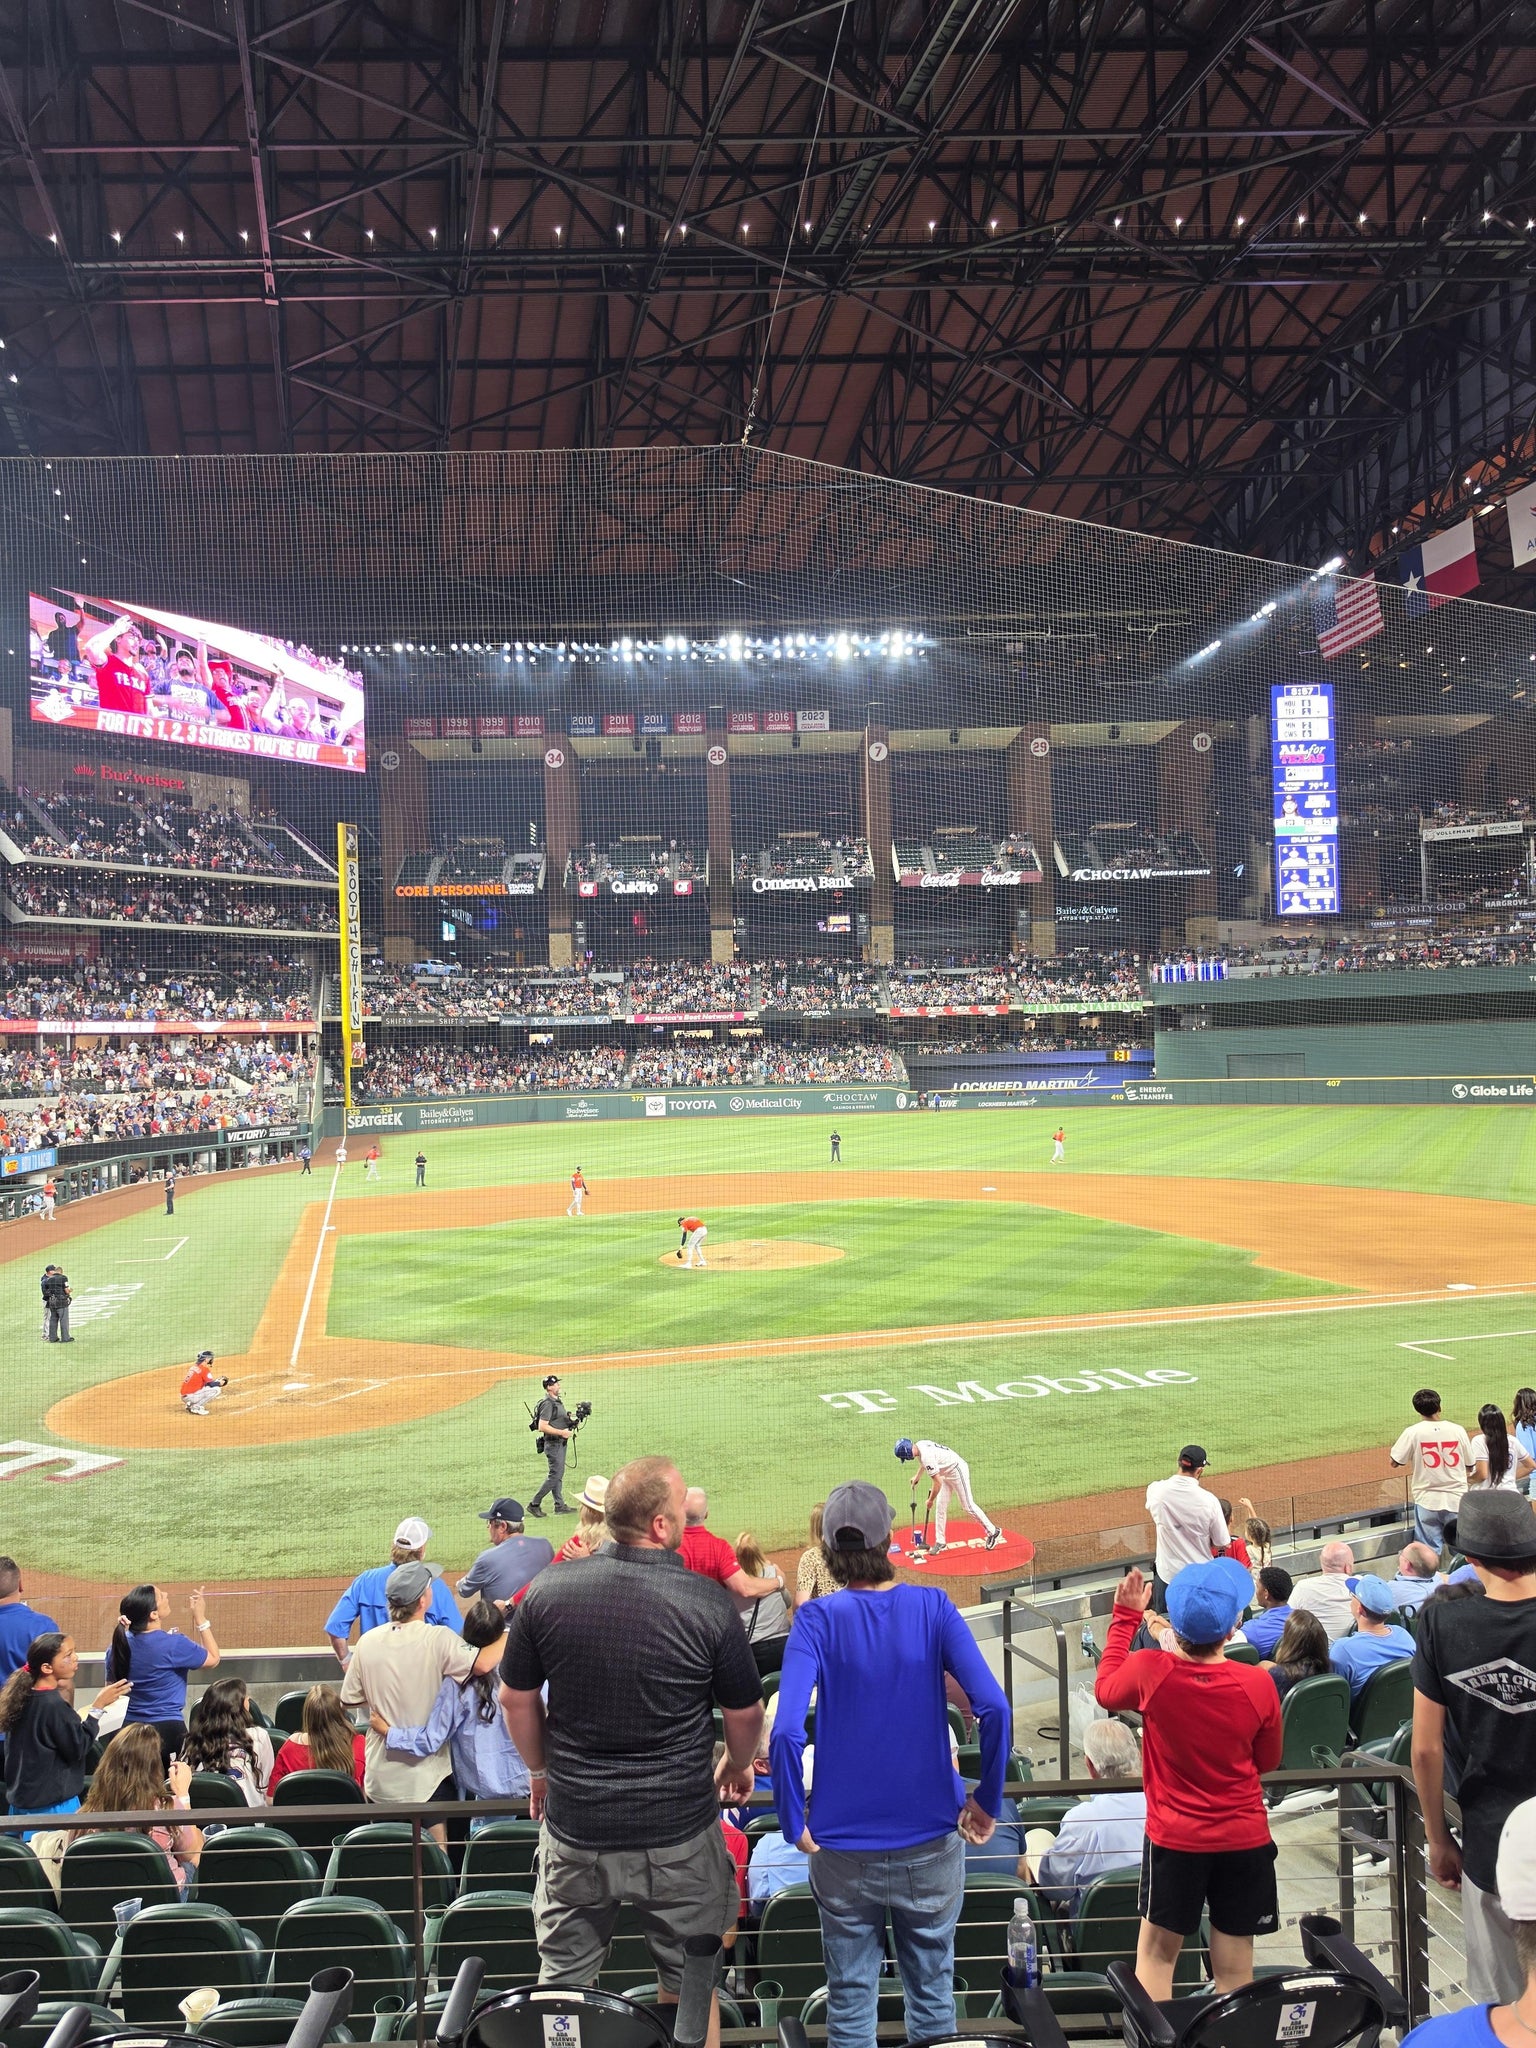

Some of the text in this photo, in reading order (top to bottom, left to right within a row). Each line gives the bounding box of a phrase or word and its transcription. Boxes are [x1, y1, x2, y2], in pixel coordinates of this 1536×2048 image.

[518, 717, 540, 726] 2010
[572, 716, 593, 725] 2010
[609, 716, 629, 724] 2011
[644, 715, 663, 724] 2011
[680, 715, 701, 724] 2012
[732, 713, 753, 722] 2015
[768, 713, 789, 721] 2016
[802, 712, 825, 720] 2023
[446, 718, 468, 726] 1998
[481, 718, 503, 726] 1999
[97, 711, 320, 760] FOR IT'S 1, 2, 3 STRIKES YOU'RE OUT
[1033, 741, 1047, 753] 29
[1197, 737, 1208, 748] 10
[710, 750, 724, 760] 26
[875, 746, 882, 757] 7
[383, 755, 398, 765] 42
[548, 754, 562, 764] 34
[100, 765, 185, 790] Budweiser
[920, 872, 961, 887] Coca-Cola
[981, 871, 1022, 886] Coca-Cola
[1080, 868, 1151, 881] CHOCTAW
[611, 881, 659, 895] QuikTrip
[818, 876, 854, 889] Bank
[396, 884, 508, 897] CORE PERSONNEL
[1387, 903, 1466, 915] PRIORITY GOLD
[1485, 899, 1529, 908] HARGROVE
[24, 945, 70, 956] FOUNDATION
[1036, 1002, 1139, 1012] LUXOR STAFFING
[953, 1079, 1078, 1091] LOCKHEED MARTIN
[1470, 1084, 1534, 1096] Globe Life
[829, 1093, 877, 1101] CHOCTAW
[669, 1100, 717, 1110] TOYOTA
[746, 1098, 802, 1109] Medical City
[347, 1112, 403, 1129] SEATGEEK
[227, 1129, 265, 1142] VICTORY
[818, 1369, 1199, 1414] T Mobile
[1420, 1441, 1460, 1469] 53
[1468, 1672, 1509, 1689] RENT
[1496, 1684, 1523, 1693] ALTUS
